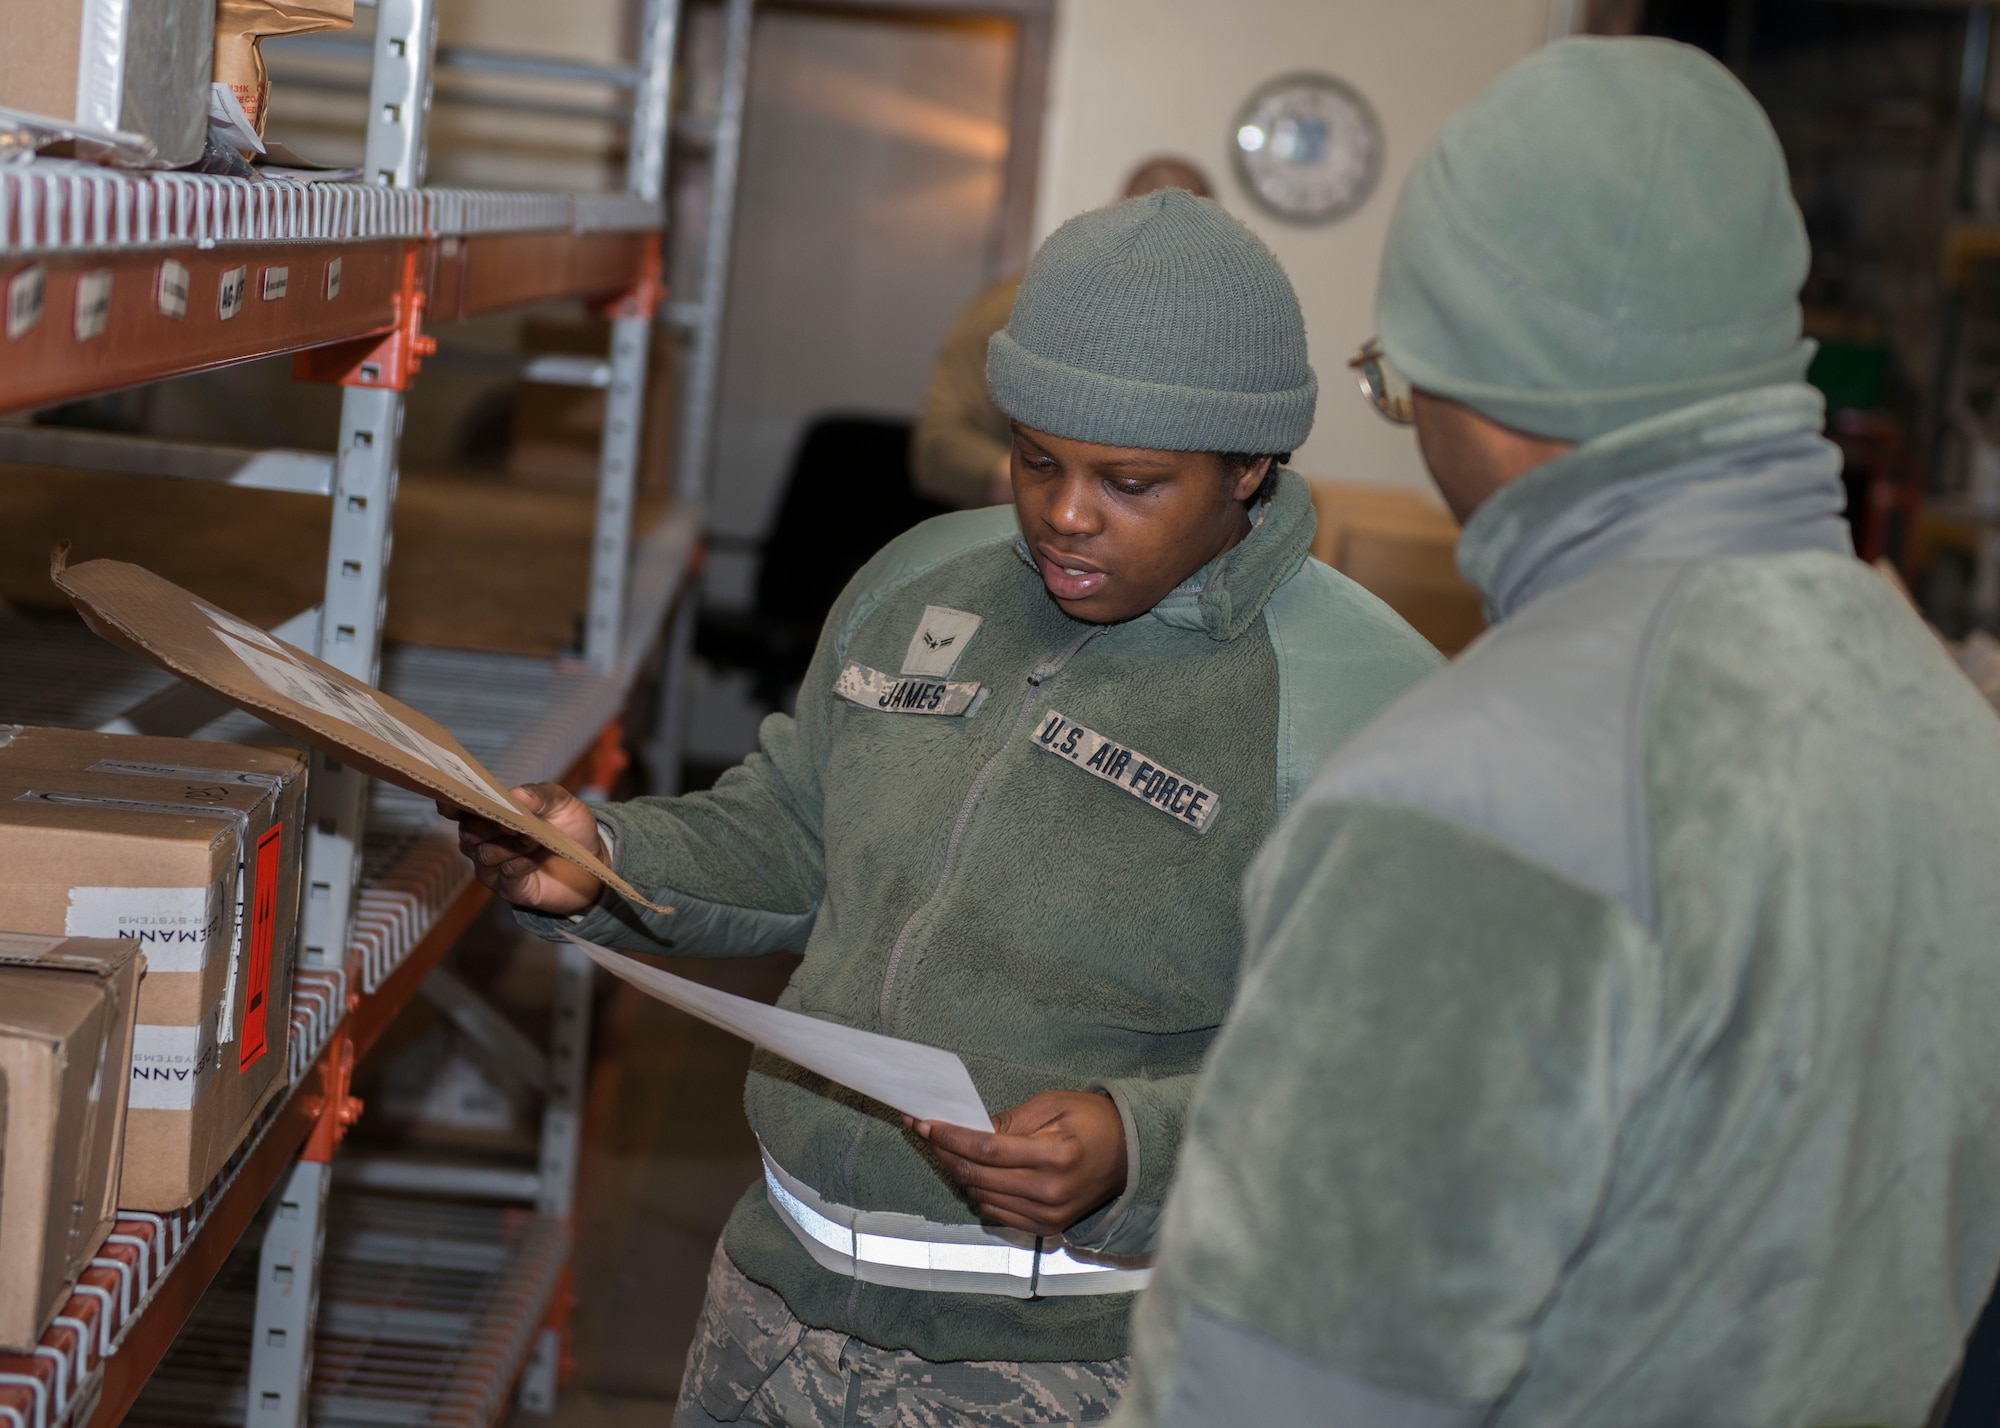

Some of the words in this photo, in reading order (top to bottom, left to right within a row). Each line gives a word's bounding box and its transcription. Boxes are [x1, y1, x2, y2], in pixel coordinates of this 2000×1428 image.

[879, 682, 946, 710] JAMES
[1041, 717, 1084, 760] U.S.
[1086, 742, 1132, 780] AIR
[1129, 760, 1209, 822] FORCE
